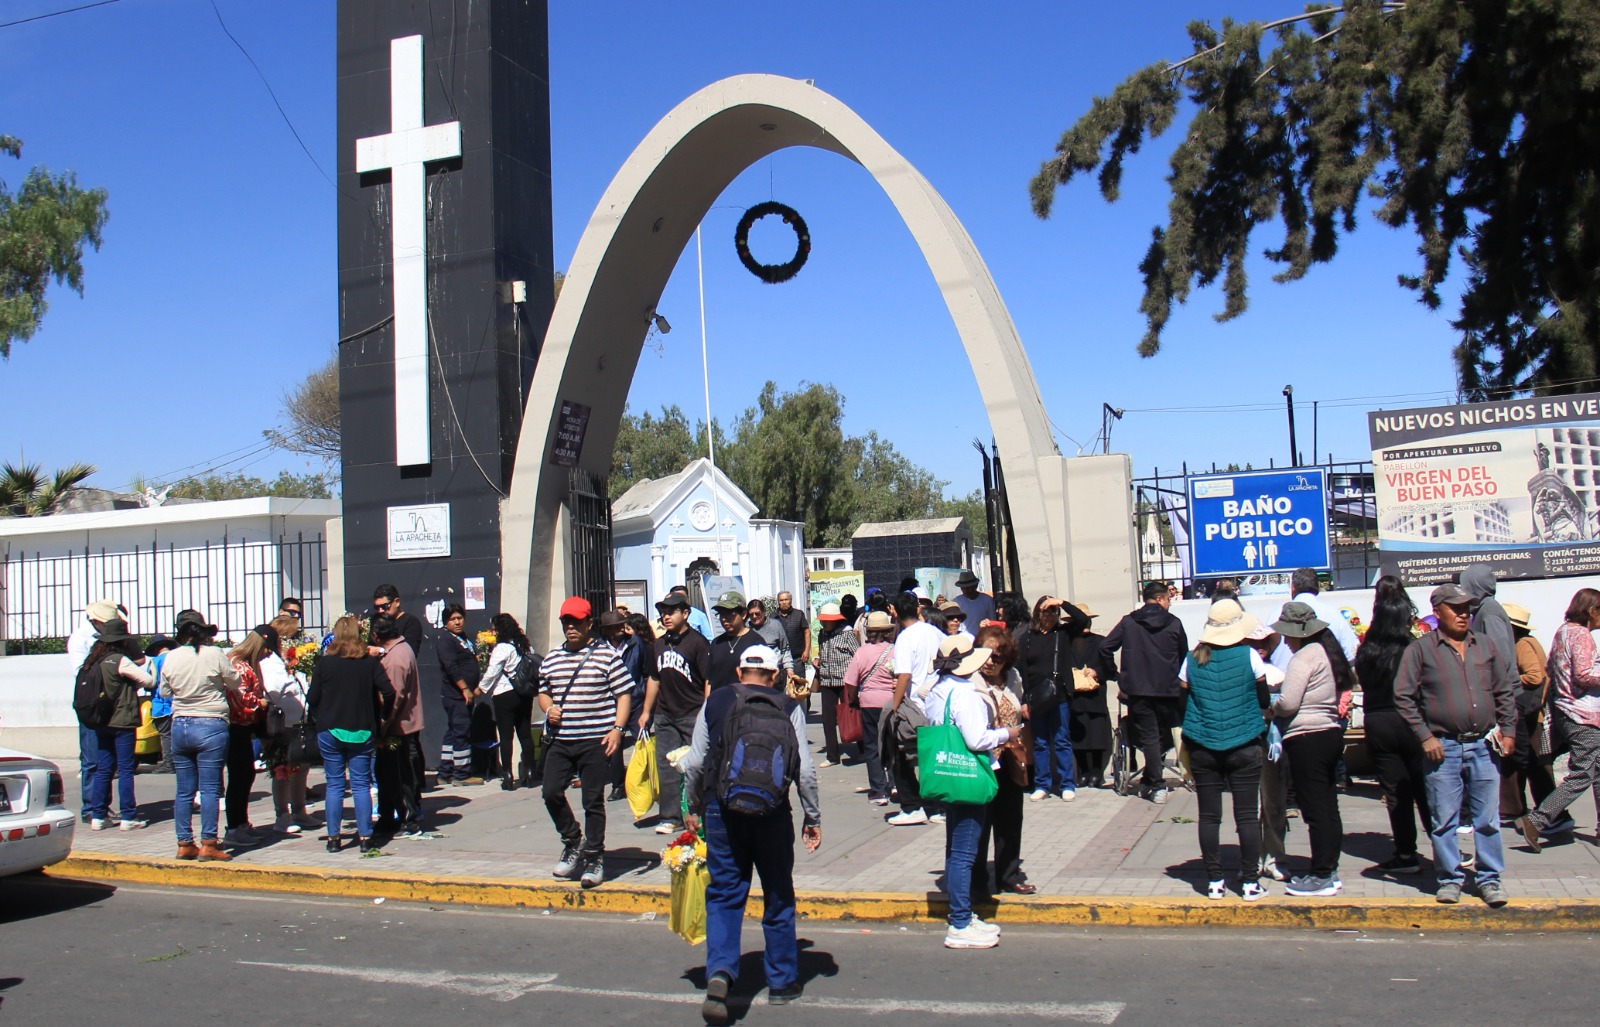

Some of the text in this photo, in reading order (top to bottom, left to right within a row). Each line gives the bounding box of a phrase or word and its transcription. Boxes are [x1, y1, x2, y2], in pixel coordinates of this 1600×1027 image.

[1375, 399, 1600, 433] NUEVOS NICHOS EN VE
[1383, 452, 1401, 460] POR
[1403, 448, 1448, 458] APERTURA
[1468, 444, 1498, 453] NUEVO
[1383, 459, 1428, 471] PABELLÓN
[1385, 466, 1492, 488] VIRGEN DEL
[1397, 481, 1498, 502] BUEN PASO
[1222, 494, 1292, 518] BAÑO
[396, 532, 442, 542] LA APACHETA
[1205, 517, 1313, 541] PÚBLICO
[1398, 552, 1531, 568] VISÍTENOS EN NUESTRAS OFICINAS:
[1542, 547, 1600, 558] CONTÁCTENOS
[1408, 564, 1470, 574] Plazoleta Cementer
